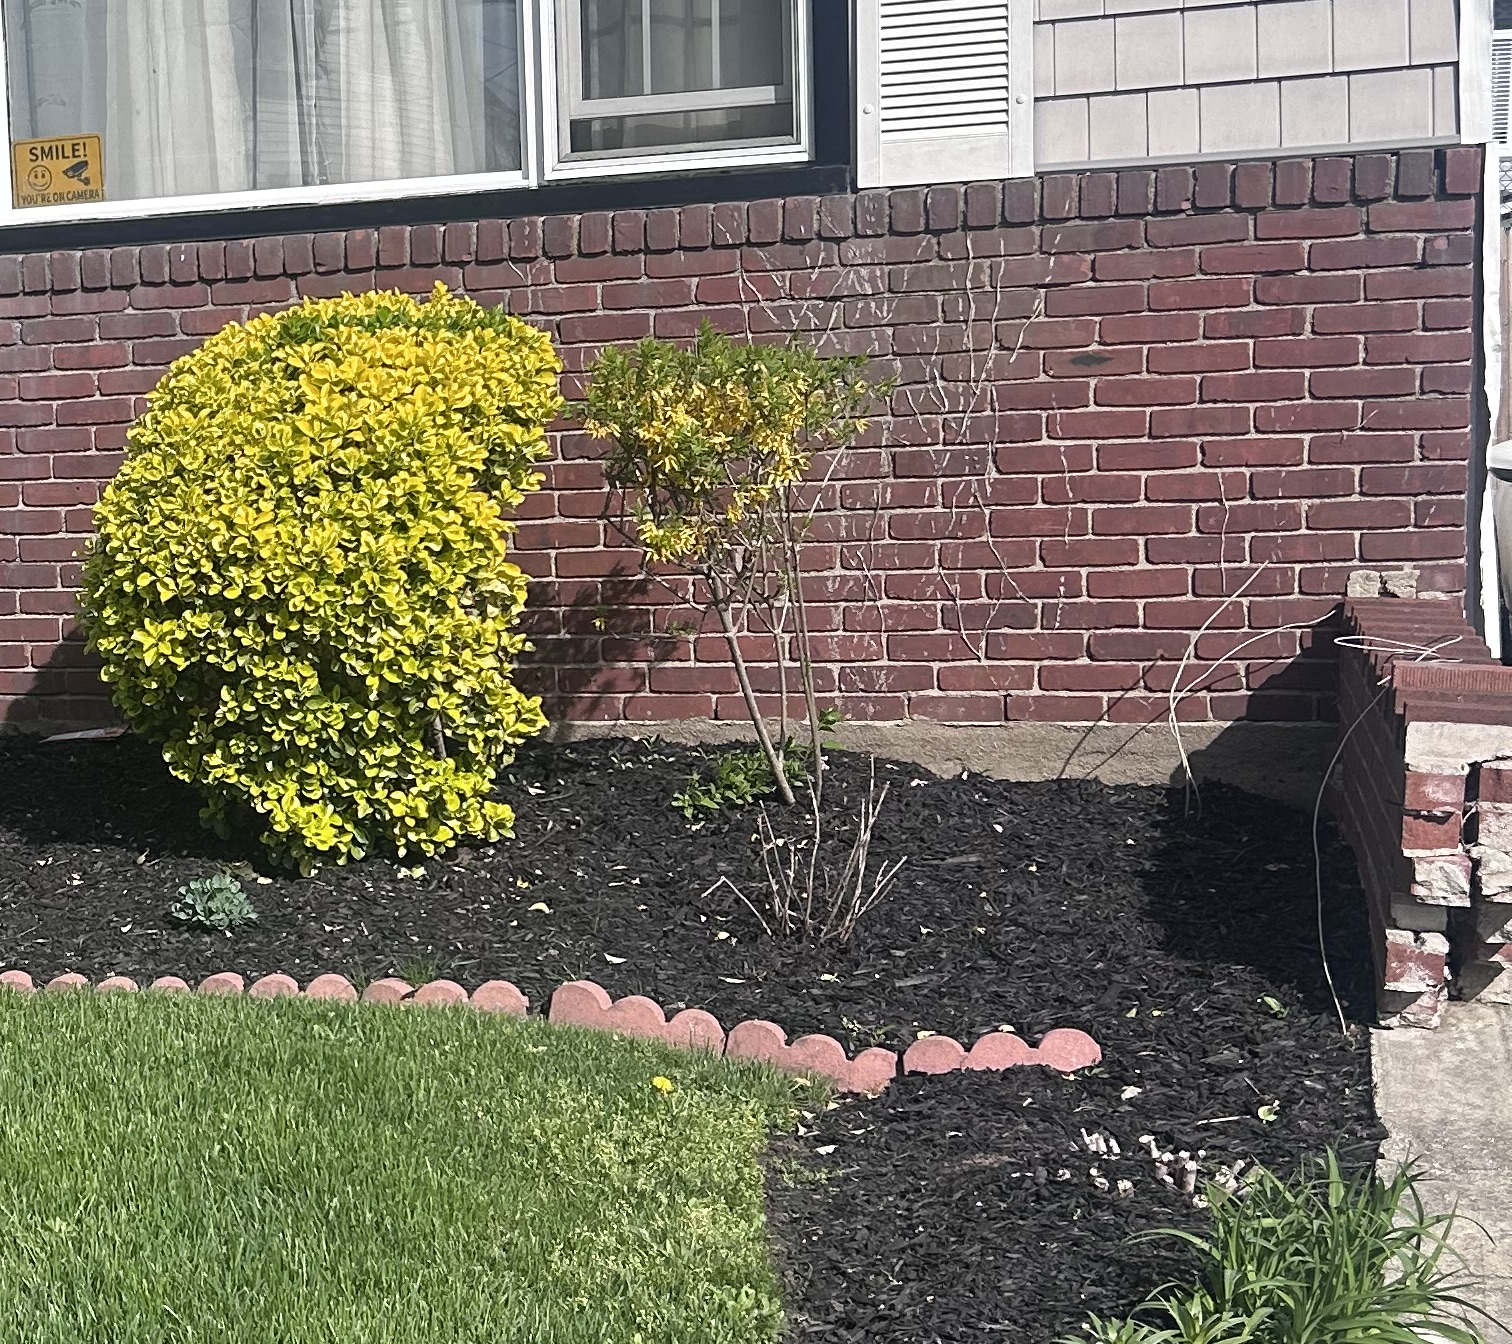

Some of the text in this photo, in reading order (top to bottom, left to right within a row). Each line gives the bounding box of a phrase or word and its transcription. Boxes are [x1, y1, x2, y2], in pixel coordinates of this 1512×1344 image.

[29, 142, 87, 162] SMILE!
[53, 191, 65, 202] ON
[66, 189, 100, 202] CAMERA
